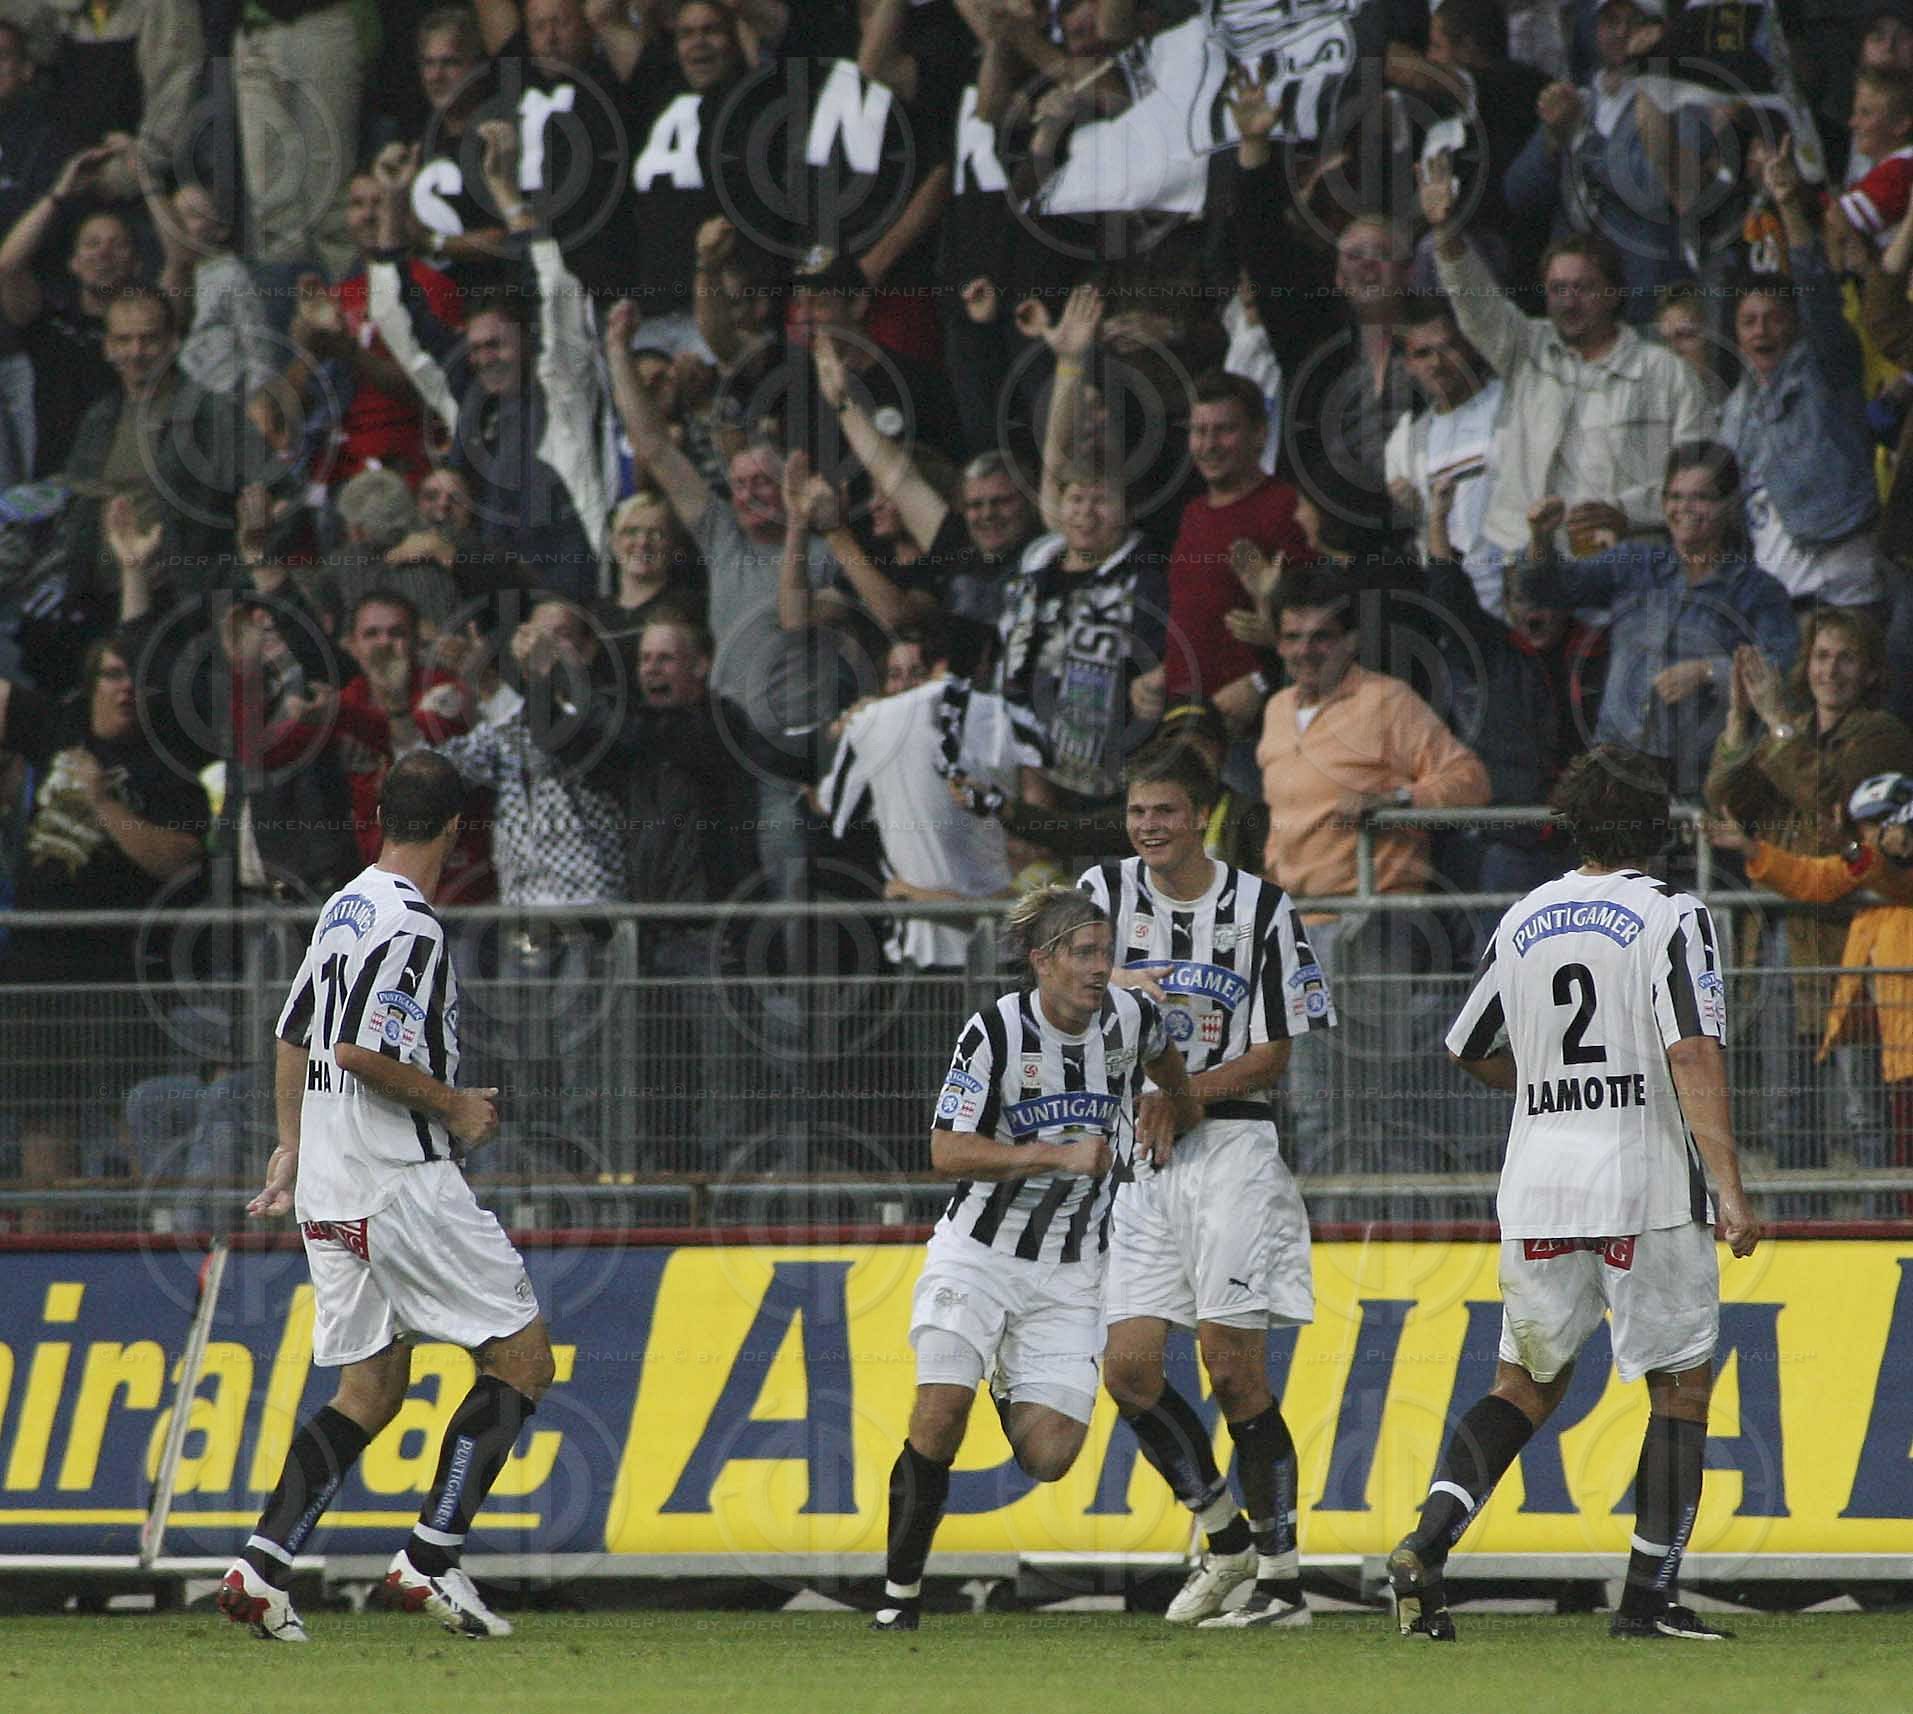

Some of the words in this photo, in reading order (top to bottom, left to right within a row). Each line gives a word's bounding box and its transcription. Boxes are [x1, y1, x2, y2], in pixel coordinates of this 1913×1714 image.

[1515, 905, 1641, 950] PUNTIGAMER
[1552, 963, 1607, 1065] 2
[1527, 1073, 1646, 1116] LAMOTTE
[434, 1438, 474, 1527] PUNTIGAMER
